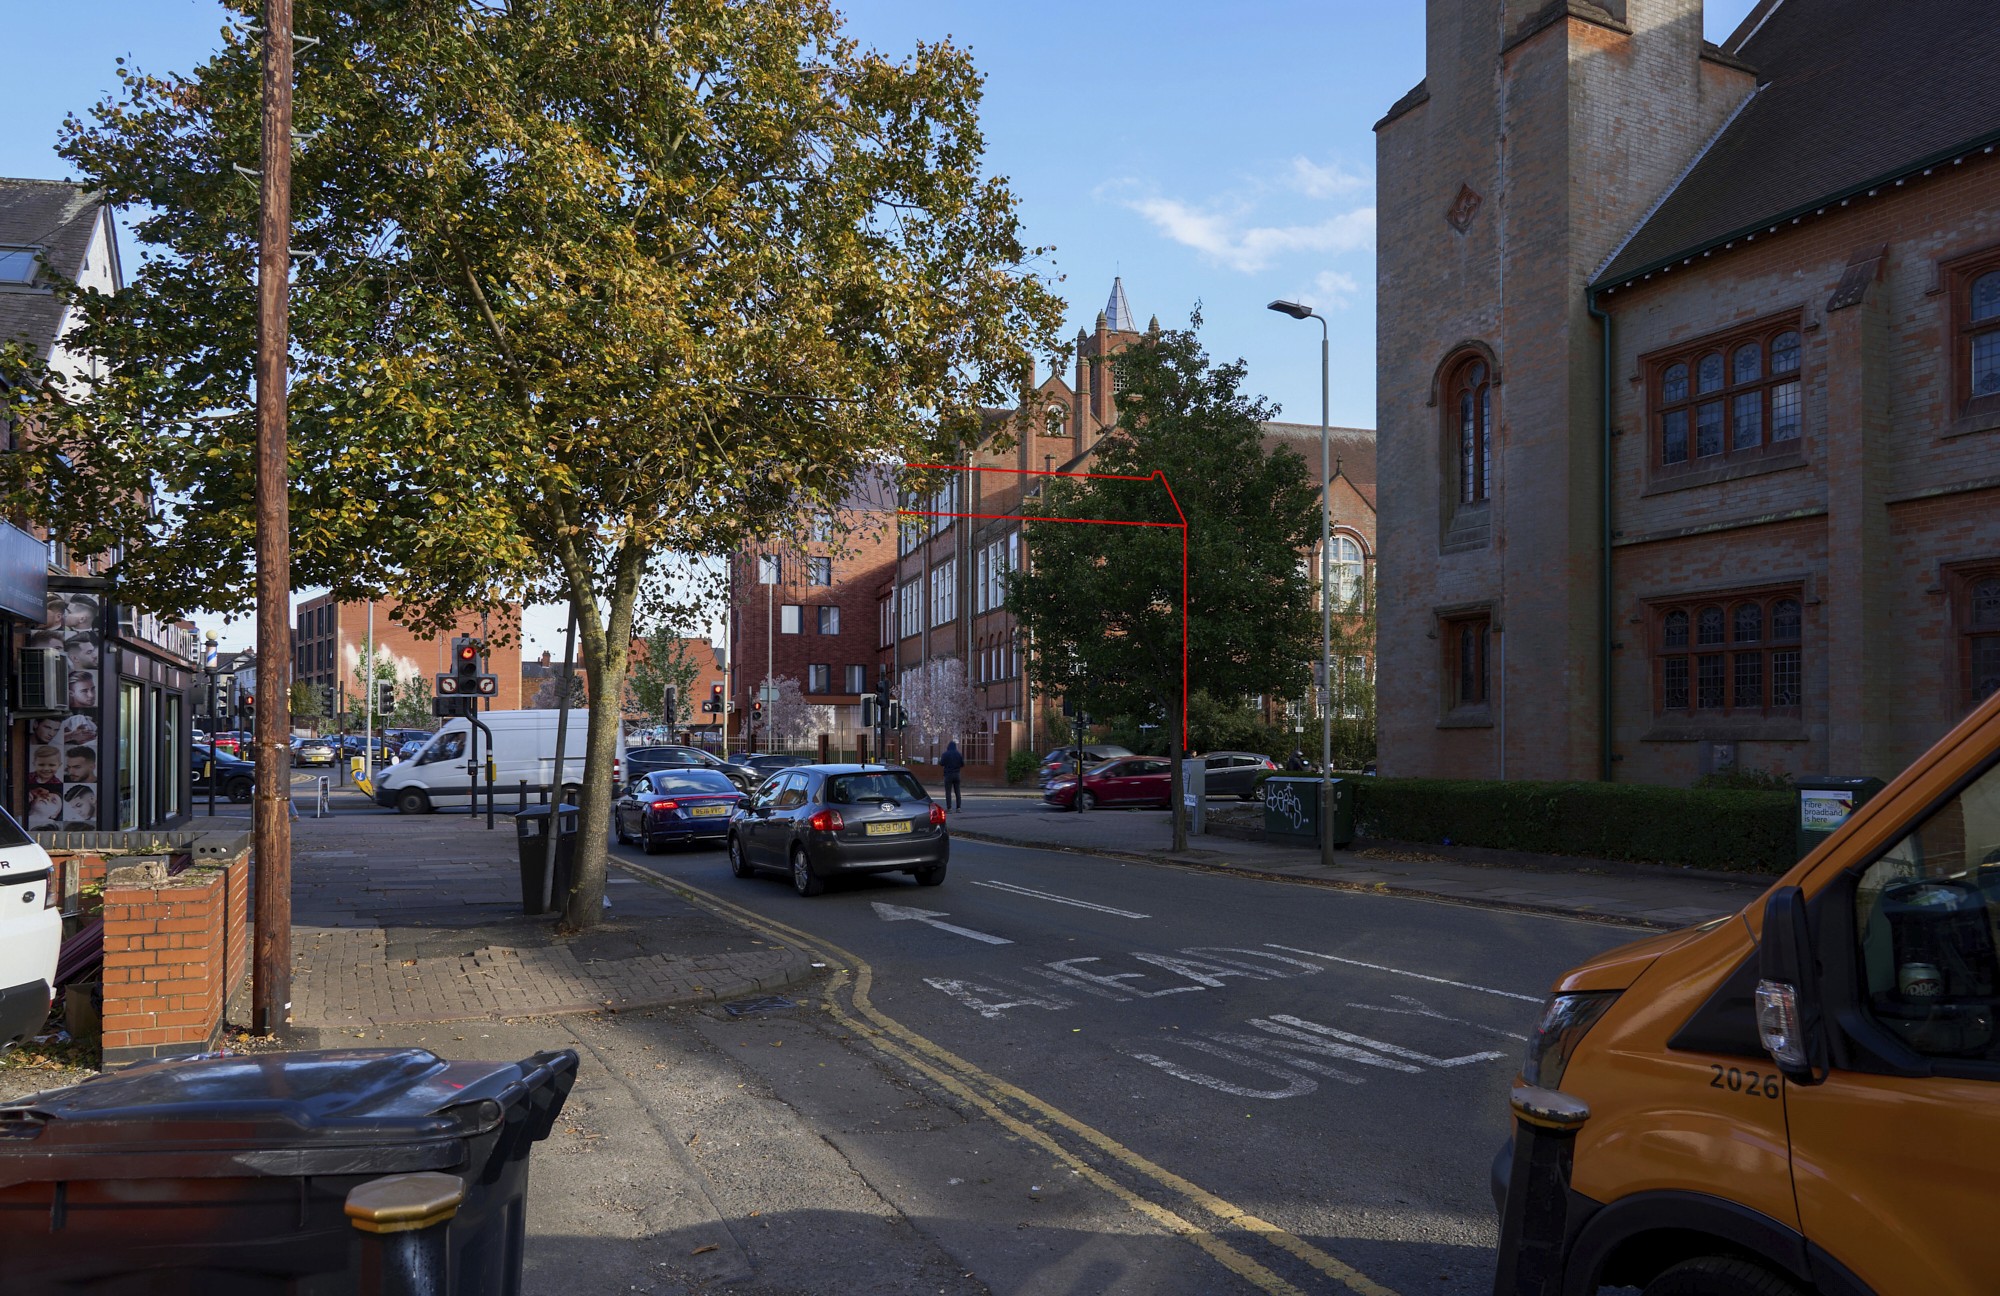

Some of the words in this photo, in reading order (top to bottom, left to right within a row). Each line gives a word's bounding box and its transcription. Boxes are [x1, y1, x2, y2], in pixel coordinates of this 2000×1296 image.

[1804, 800, 1822, 808] Fibre
[1804, 808, 1842, 816] broadband
[1811, 815, 1828, 823] here
[922, 946, 1324, 1019] AHEAD
[1710, 1064, 1780, 1099] 2026
